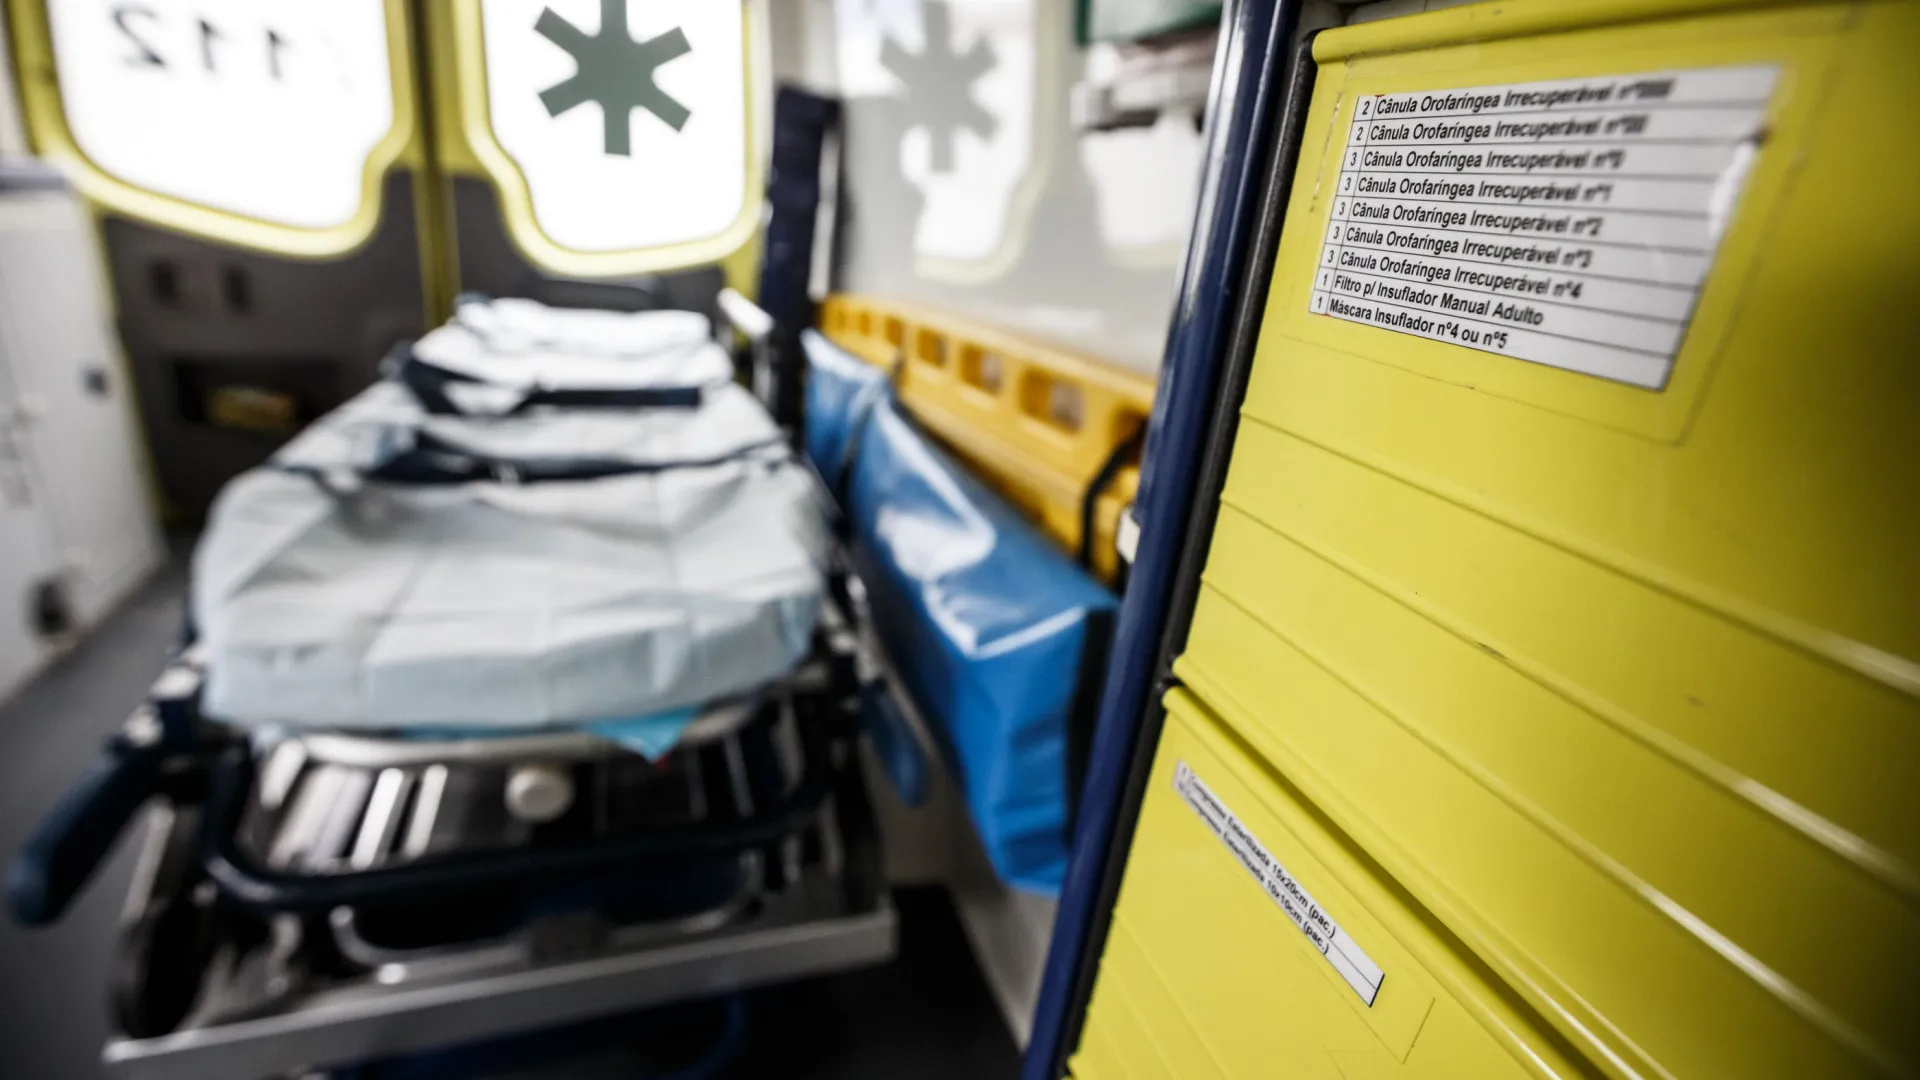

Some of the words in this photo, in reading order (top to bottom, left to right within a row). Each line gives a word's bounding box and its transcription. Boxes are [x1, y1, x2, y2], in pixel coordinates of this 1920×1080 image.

[1362, 101, 1368, 115] 2
[1377, 97, 1418, 114] Cânula
[1421, 93, 1499, 113] Orofaríngea
[1356, 127, 1363, 141] 2
[1370, 123, 1409, 141] Cânula
[1413, 120, 1490, 142] Orofaríngea
[1350, 153, 1357, 166] 3
[1364, 150, 1402, 168] Cânula
[1406, 150, 1481, 172] Orofaríngea
[1344, 177, 1351, 191] 3
[1358, 177, 1396, 194] Cânula
[1400, 178, 1475, 200] Orofaríngea
[1339, 202, 1345, 216] 3
[1352, 203, 1390, 220] Cânula
[1393, 204, 1466, 227] Orofaríngea
[1470, 209, 1571, 233] Irrecuperável
[1333, 226, 1340, 239] 3
[1346, 227, 1383, 245] Cânula
[1386, 230, 1459, 255] Orofaríngea
[1462, 238, 1562, 264] Irrecuperável
[1328, 250, 1334, 263] 3
[1340, 251, 1376, 270] Cânula
[1380, 256, 1452, 282] Orofaríngea
[1454, 266, 1551, 294] Irrecuperável
[1323, 273, 1328, 286] 1
[1334, 275, 1361, 292] Filtro
[1363, 281, 1376, 297] p/
[1377, 282, 1438, 306] Insuflador
[1440, 292, 1490, 315] Manual
[1492, 302, 1544, 326] Adulto
[1318, 296, 1323, 308] 1
[1329, 298, 1372, 320] Máscara
[1375, 308, 1435, 334] Insuflador
[1462, 329, 1479, 343] ou
[1302, 920, 1330, 955] (pac.)
[1308, 904, 1337, 939] (pac.)
